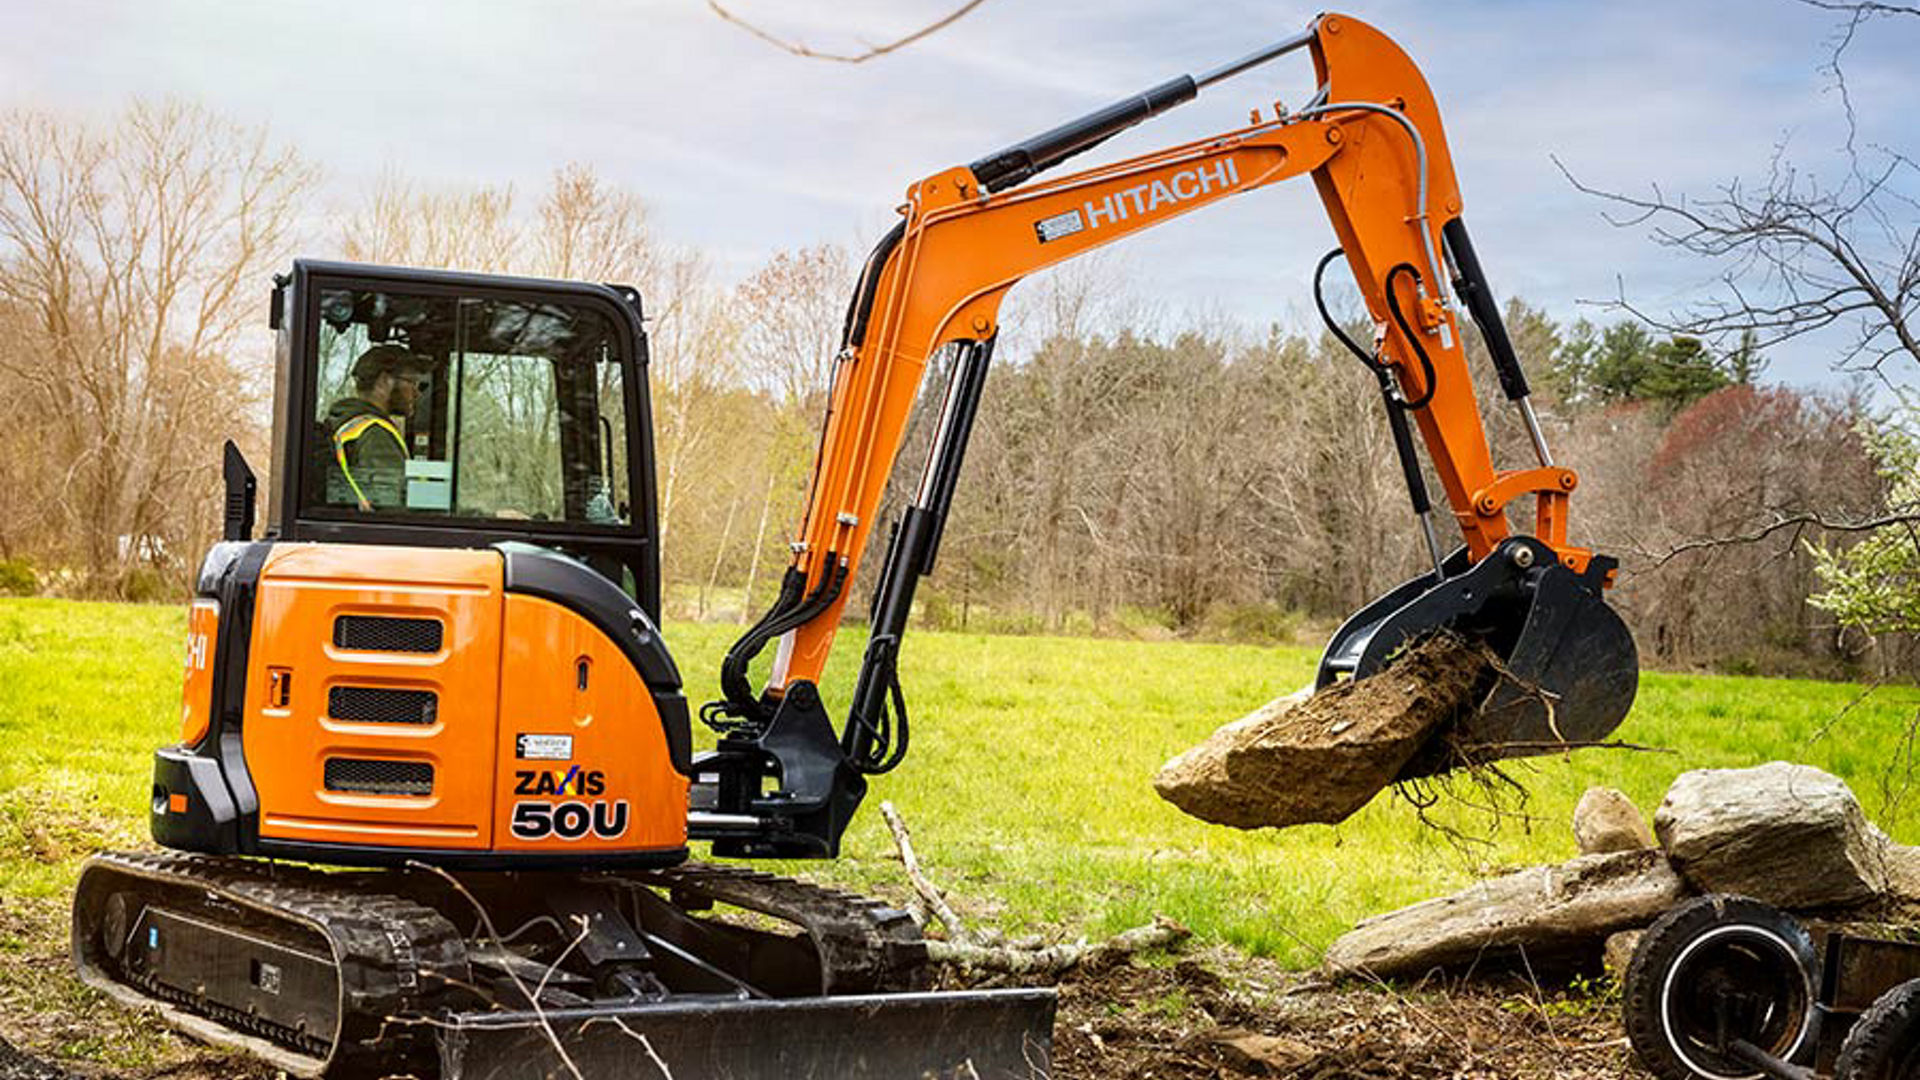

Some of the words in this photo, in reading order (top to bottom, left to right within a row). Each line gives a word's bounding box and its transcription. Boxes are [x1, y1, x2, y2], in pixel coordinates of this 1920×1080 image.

[1085, 158, 1239, 228] HITACHI
[515, 765, 605, 795] ZAXIS
[511, 800, 629, 840] 50U
